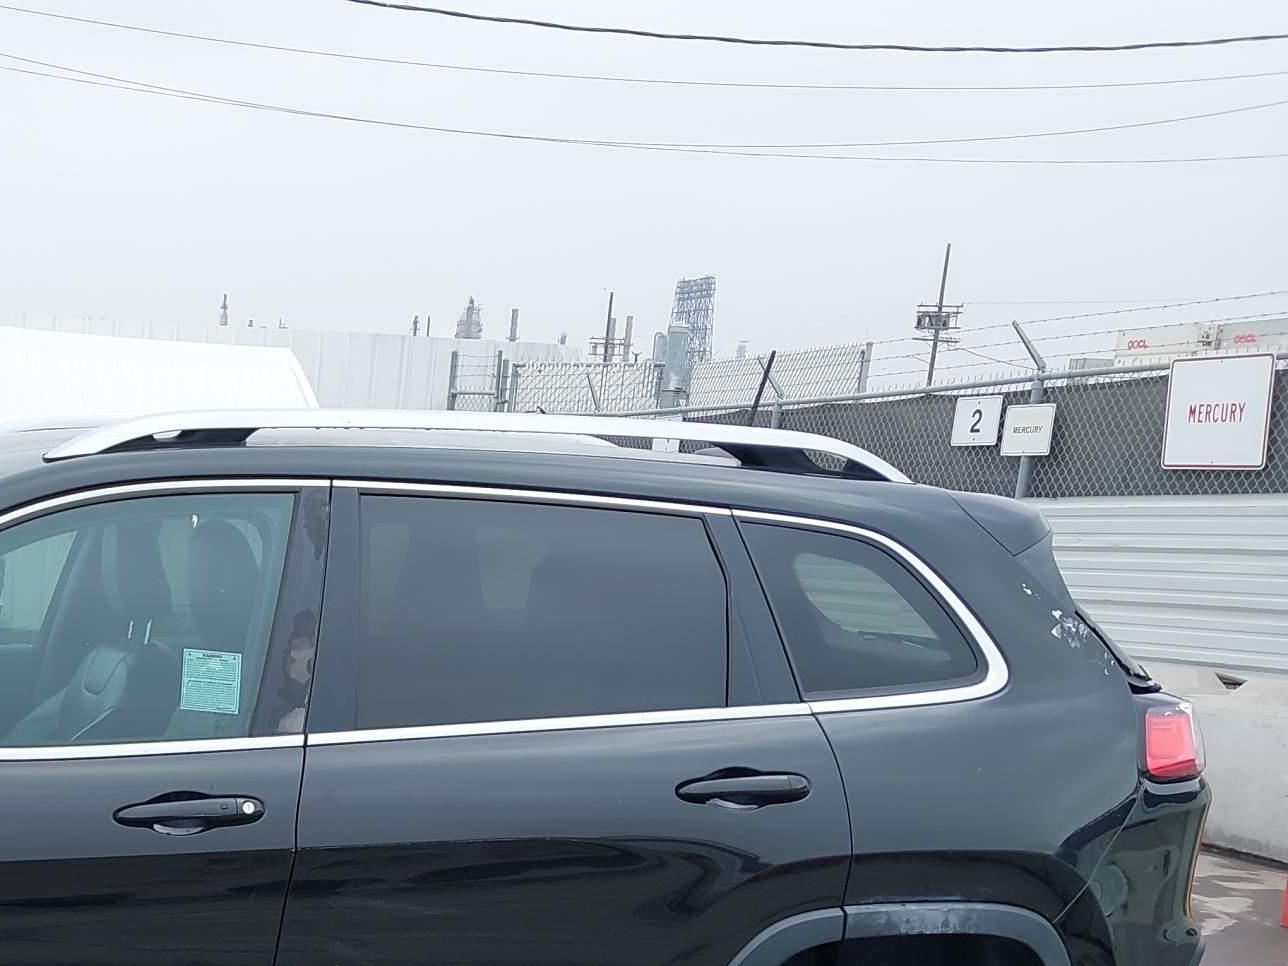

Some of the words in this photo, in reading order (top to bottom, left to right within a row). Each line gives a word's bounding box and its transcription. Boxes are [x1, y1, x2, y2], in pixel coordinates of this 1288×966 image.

[970, 409, 982, 433] 2
[1188, 402, 1245, 423] MERCURY
[1013, 426, 1043, 434] MERCURY
